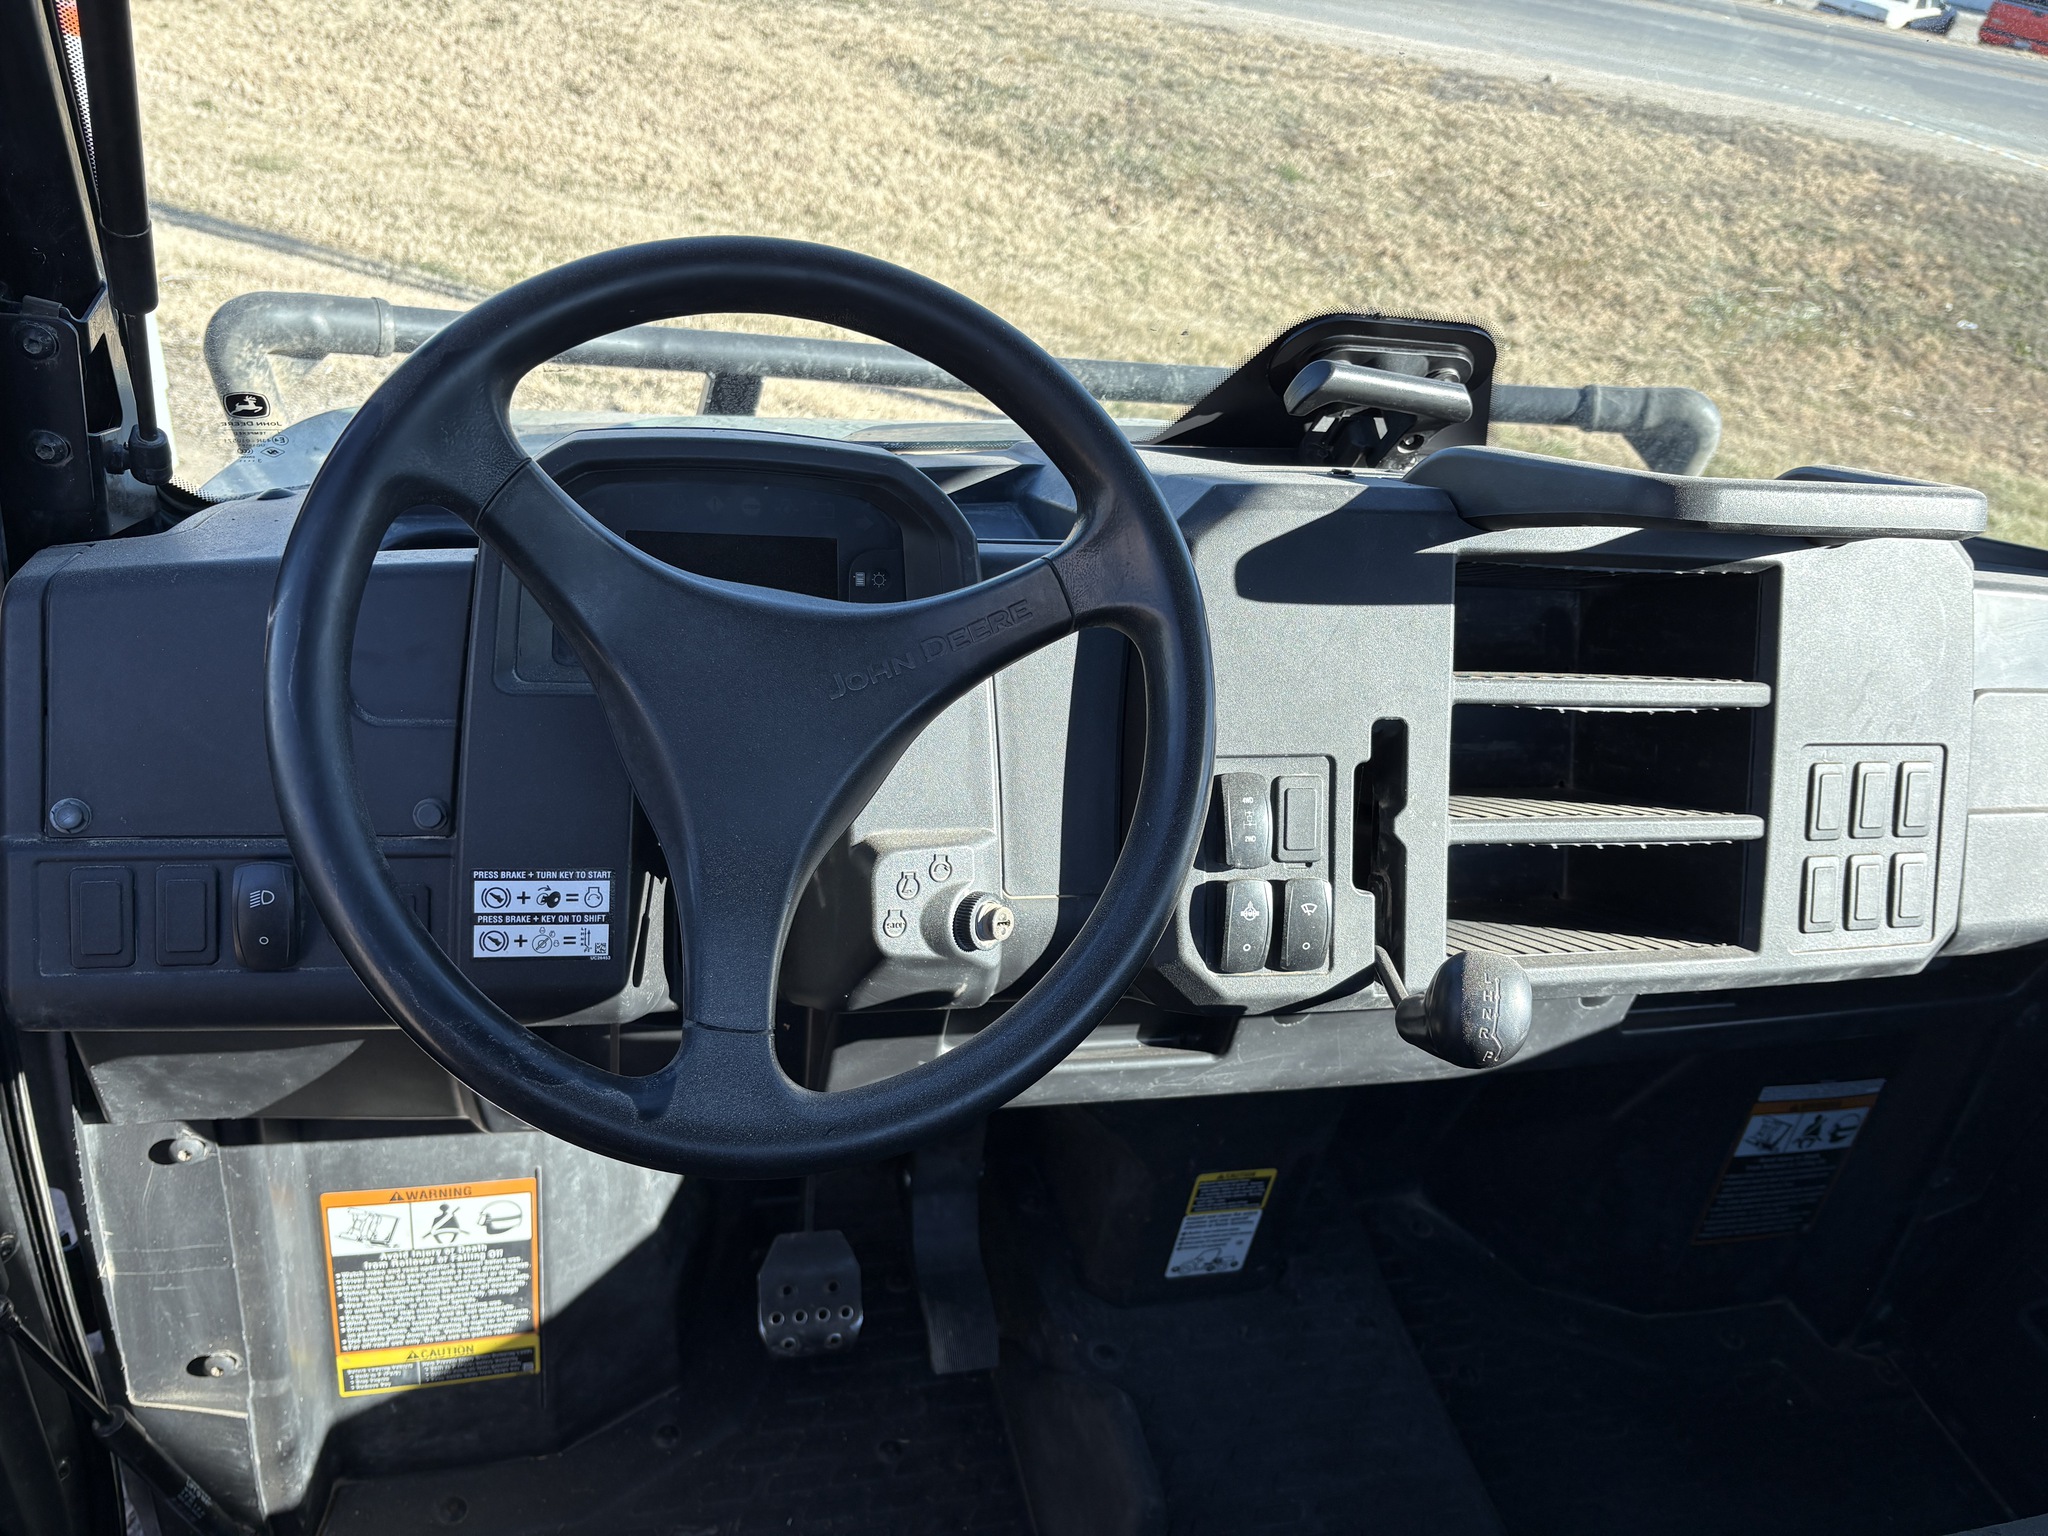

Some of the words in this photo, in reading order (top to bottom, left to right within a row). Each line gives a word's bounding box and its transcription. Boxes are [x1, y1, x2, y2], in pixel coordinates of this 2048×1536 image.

[831, 653, 916, 700] JOHN
[920, 600, 1034, 662] DEERE
[473, 870, 499, 879] PRESS
[501, 870, 526, 879] BRAKE
[536, 871, 558, 879] TURN
[559, 870, 575, 879] KEY
[576, 870, 586, 878] TO
[588, 870, 612, 878] START
[477, 915, 503, 923] PRESS
[505, 915, 531, 923] BRAKE
[541, 915, 558, 923] KEY
[558, 915, 568, 923] ON
[584, 914, 606, 922] SHIFT
[1484, 972, 1492, 984] L
[1483, 990, 1493, 1002] H
[1482, 1008, 1492, 1020] N
[1479, 1027, 1490, 1039] R
[1483, 1051, 1494, 1062] P
[406, 1186, 472, 1200] WARNING
[380, 1251, 409, 1261] Avoid
[411, 1248, 442, 1259] Injury
[444, 1247, 456, 1255] or
[457, 1244, 487, 1254] Death
[364, 1260, 389, 1270] from
[390, 1256, 435, 1268] Rollover
[437, 1256, 449, 1264] or
[450, 1252, 486, 1264] Falling
[487, 1249, 503, 1259] Off
[421, 1345, 474, 1359] CAUTION
